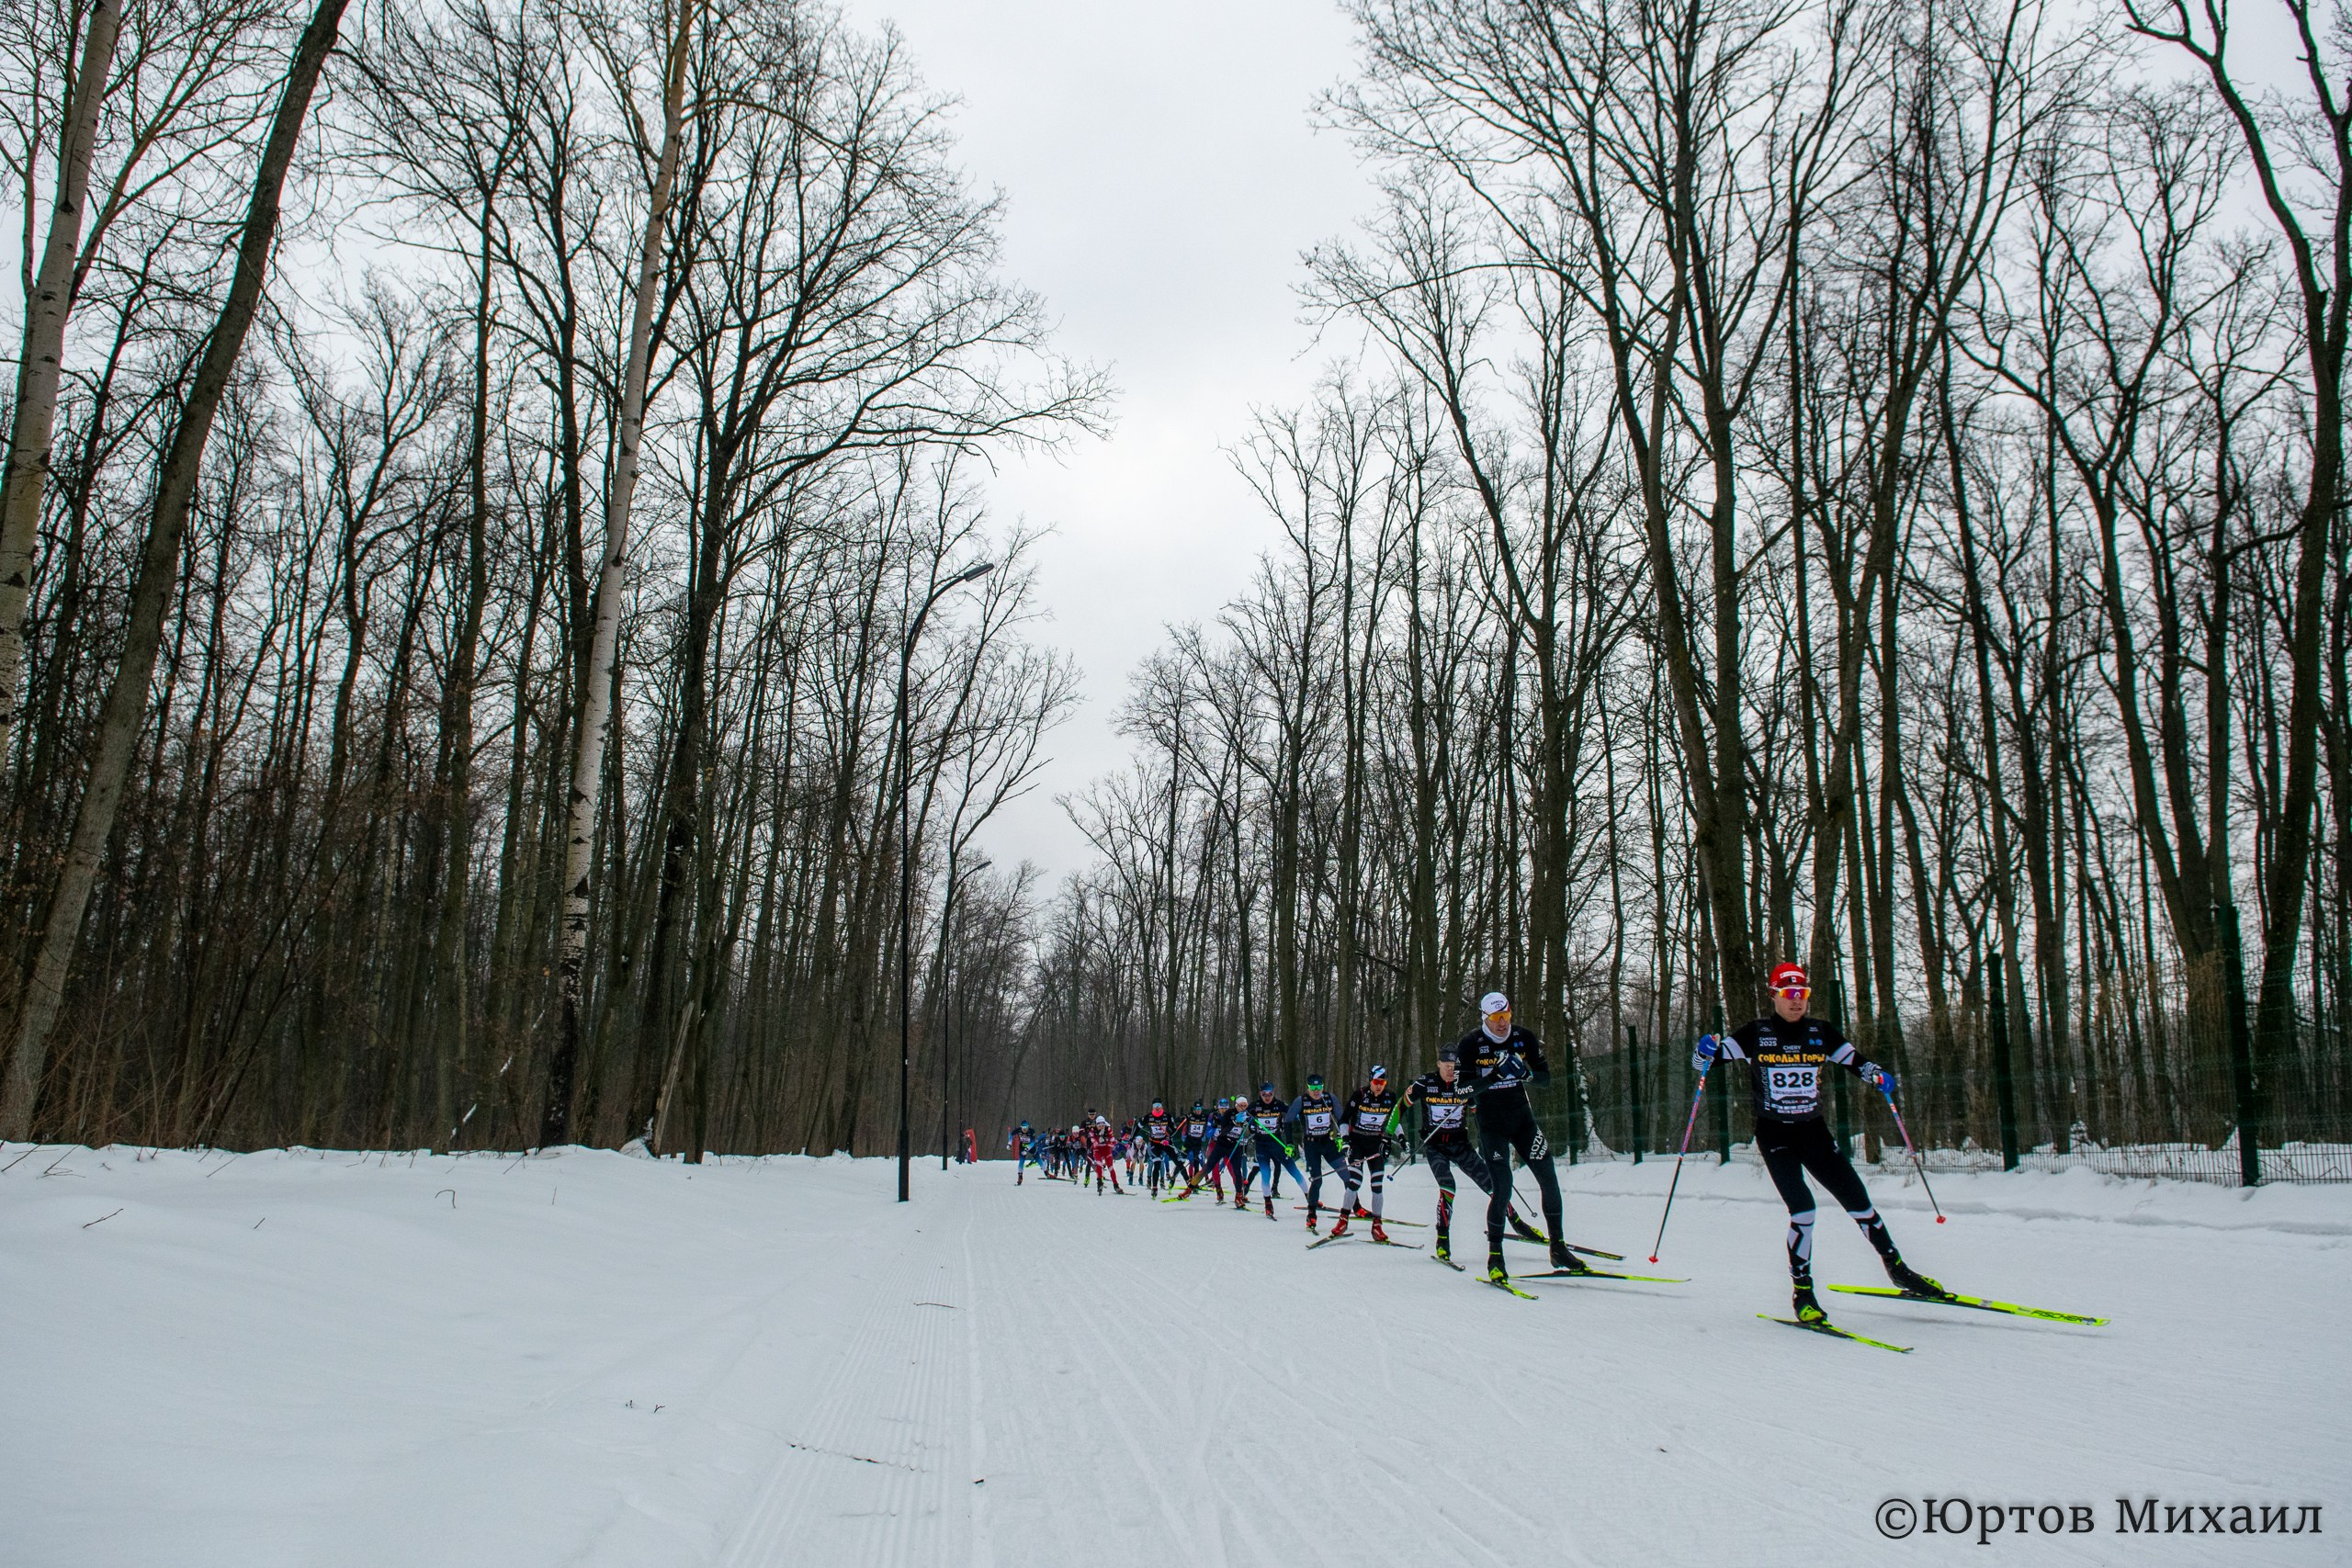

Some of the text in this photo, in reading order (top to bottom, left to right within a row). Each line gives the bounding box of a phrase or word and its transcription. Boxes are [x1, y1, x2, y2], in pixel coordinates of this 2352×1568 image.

[1803, 1054, 1826, 1063] ГОРЫ
[1773, 1072, 1814, 1088] 828
[1443, 1109, 1452, 1117] 3
[2030, 1309, 2084, 1323] FISCHER
